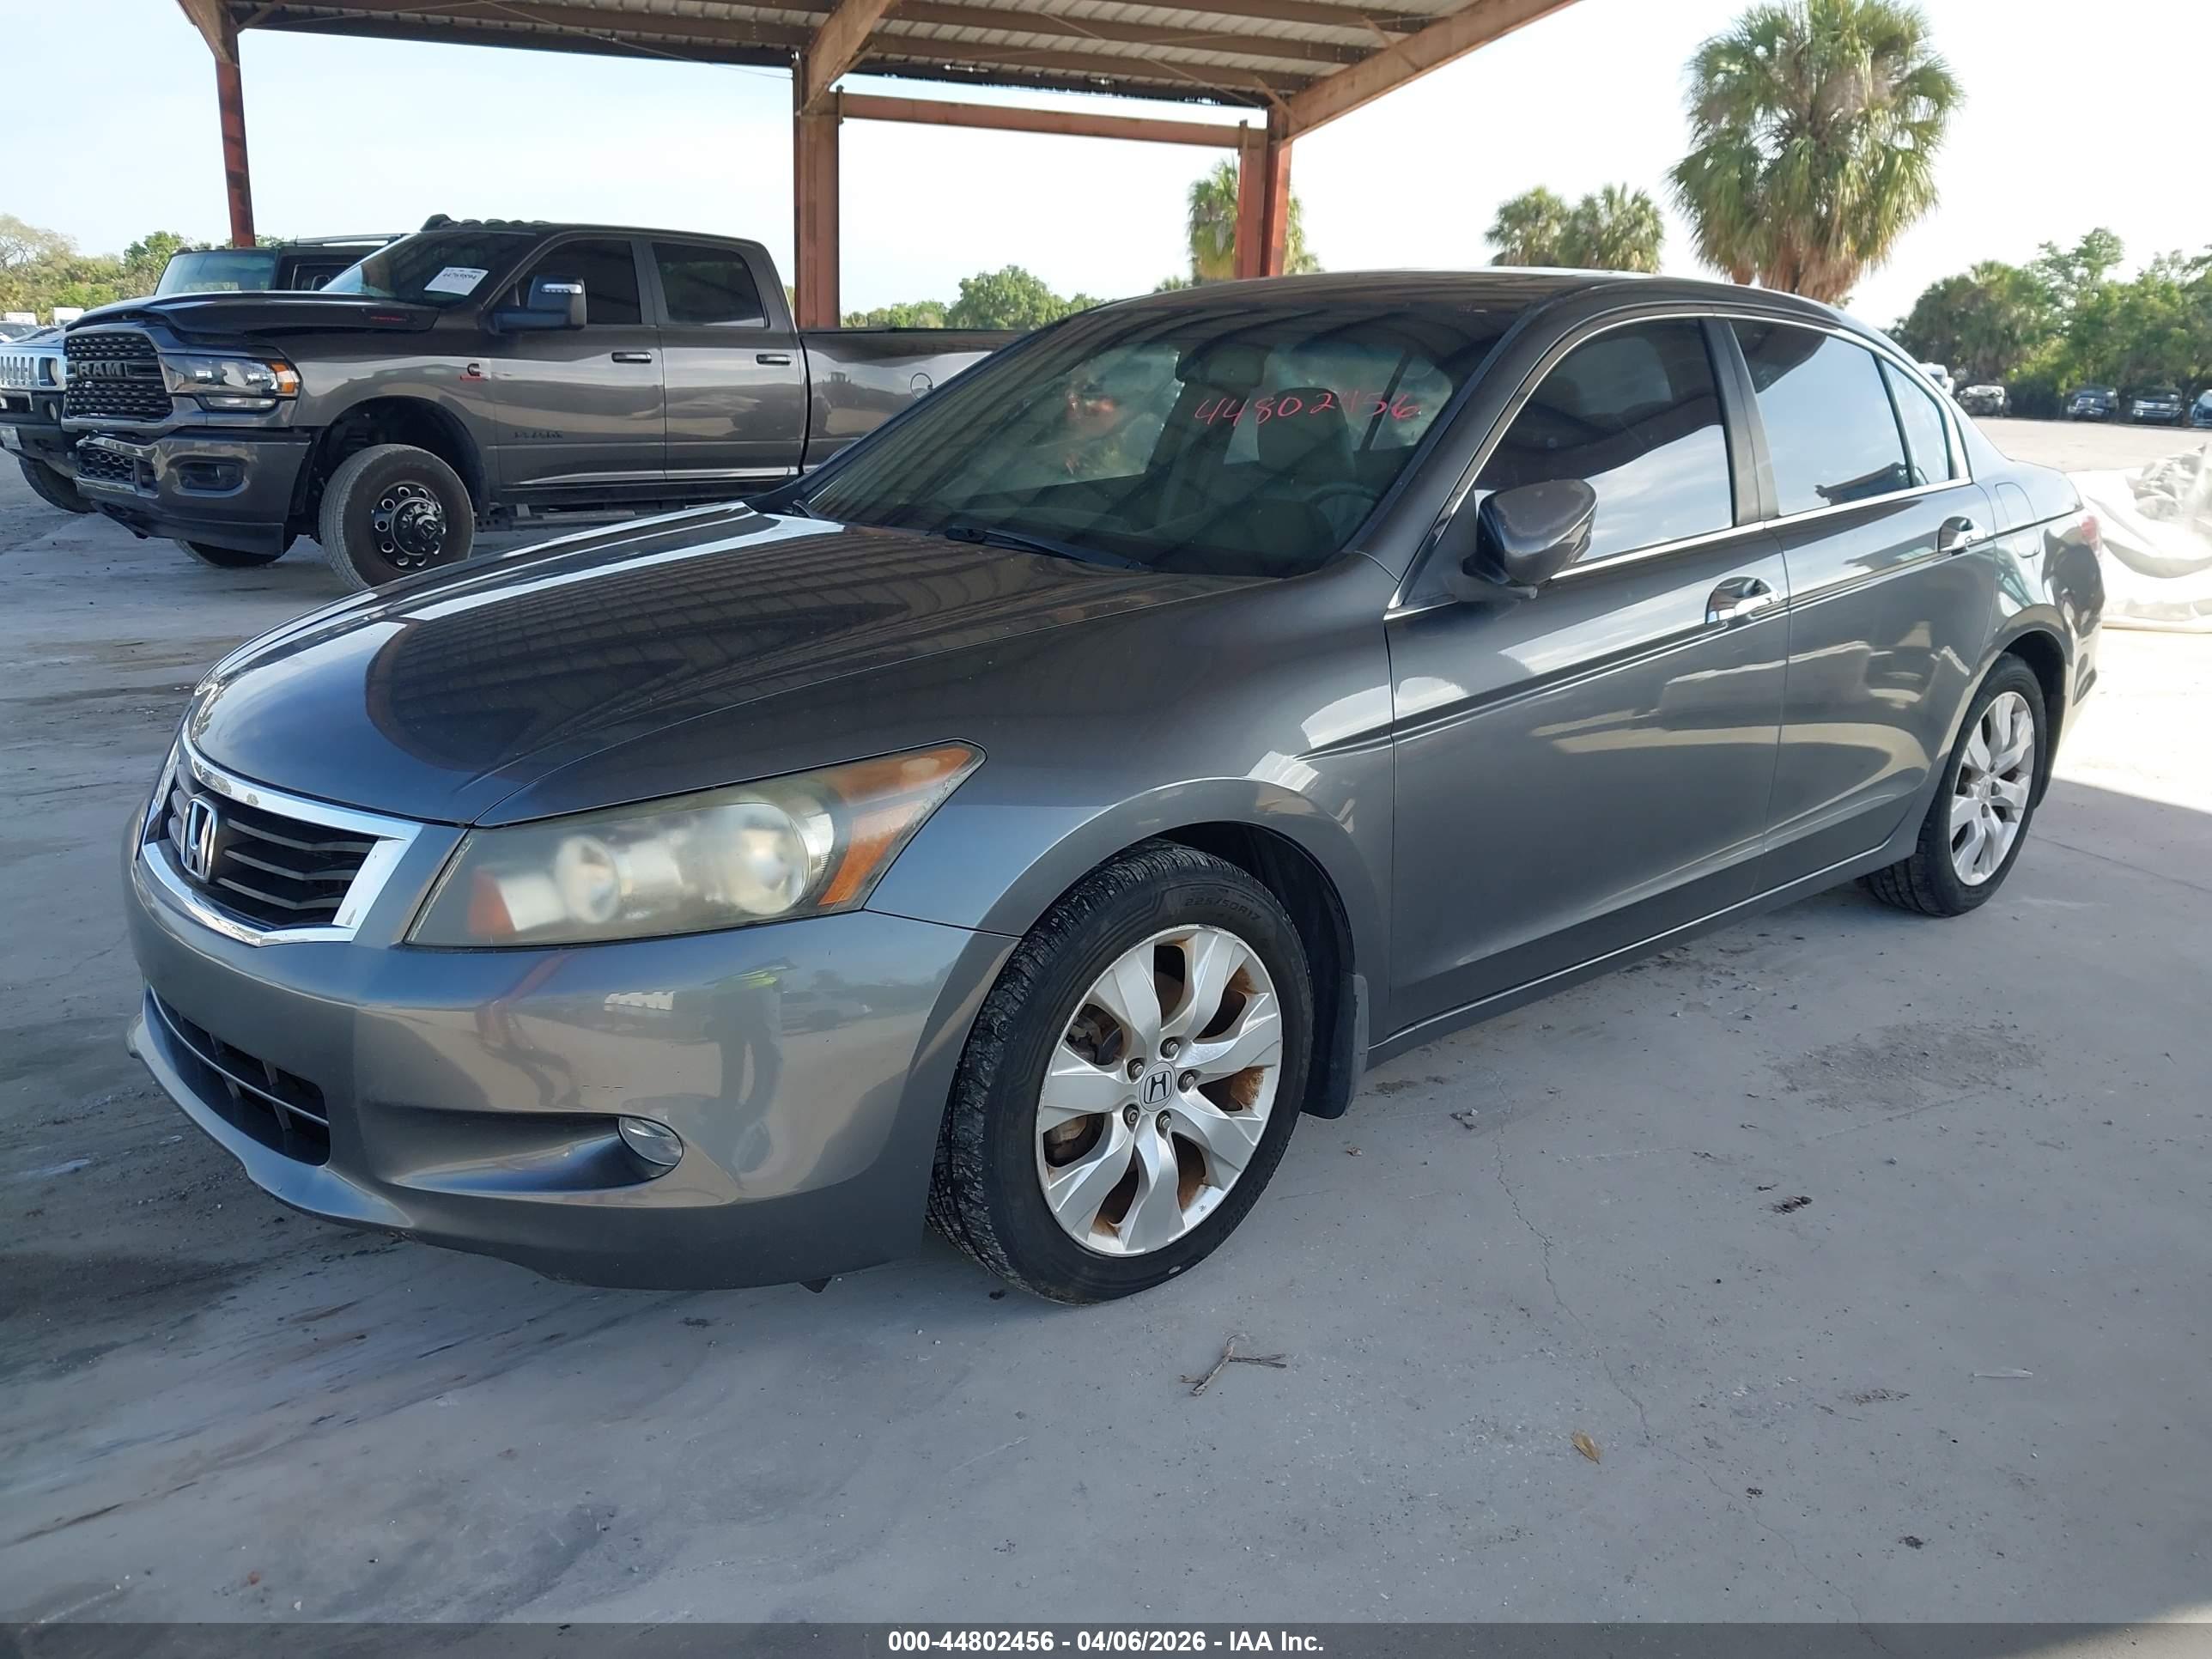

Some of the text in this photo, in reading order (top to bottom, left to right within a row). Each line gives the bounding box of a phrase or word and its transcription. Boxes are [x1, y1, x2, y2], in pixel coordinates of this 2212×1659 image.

[78, 362, 122, 377] RAM
[1194, 392, 1419, 427] 44802456
[1184, 896, 1262, 921] 225/50R17
